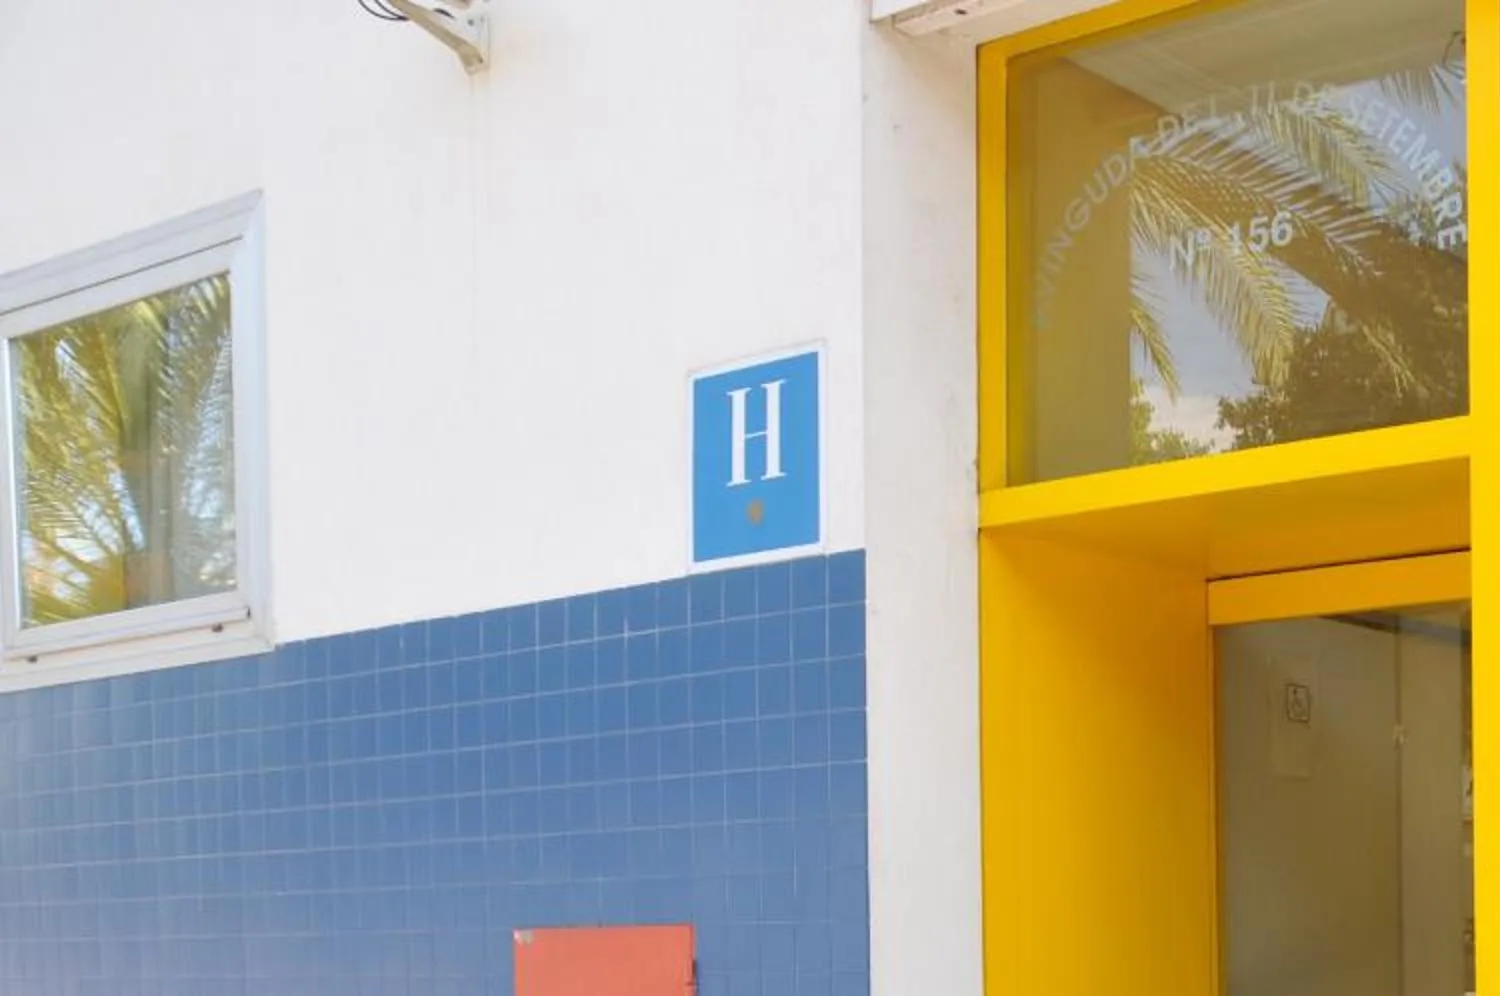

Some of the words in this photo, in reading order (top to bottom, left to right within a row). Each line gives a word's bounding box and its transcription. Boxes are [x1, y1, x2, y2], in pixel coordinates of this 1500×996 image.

[1344, 94, 1468, 250] SETEMBRE
[1227, 210, 1294, 257] 156
[725, 378, 788, 487] H
